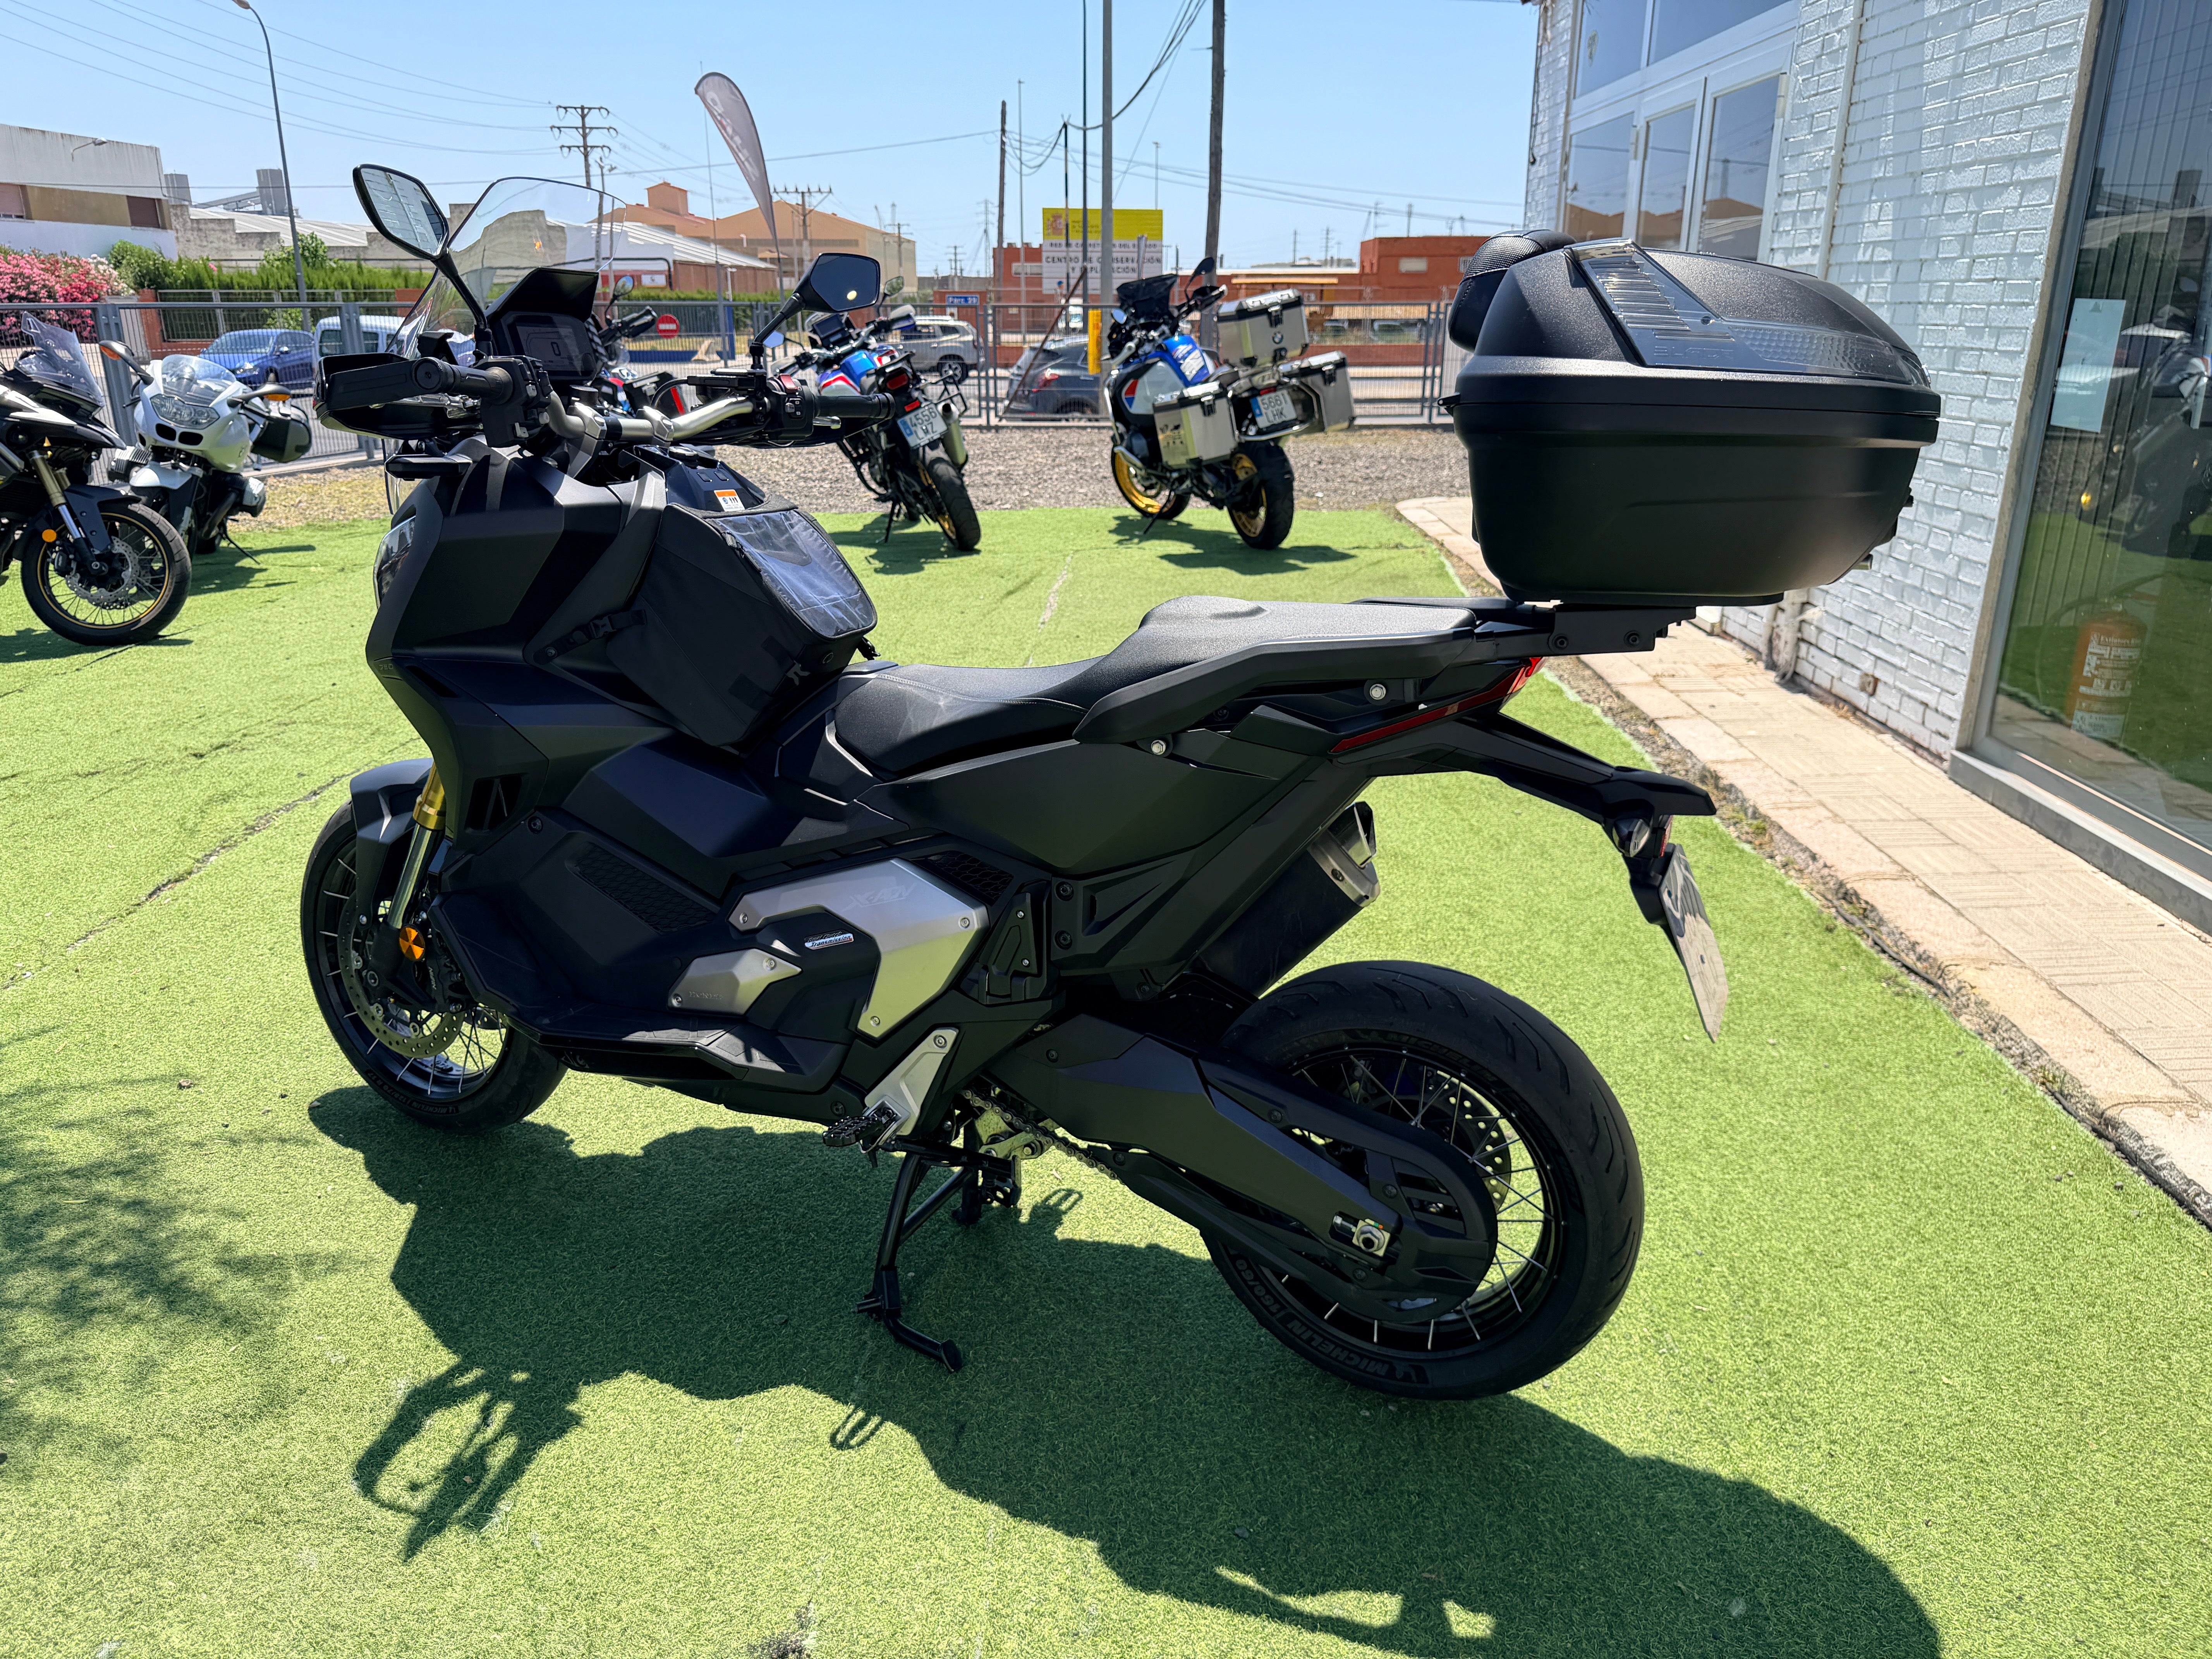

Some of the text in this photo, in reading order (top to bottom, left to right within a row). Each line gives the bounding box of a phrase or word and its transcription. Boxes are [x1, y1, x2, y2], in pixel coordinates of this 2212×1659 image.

[551, 342, 561, 356] 0
[1261, 393, 1288, 410] 5661
[910, 407, 938, 427] 4556
[1264, 407, 1287, 423] LHK
[811, 935, 851, 947] Transmission
[823, 931, 843, 939] Clutch
[411, 1101, 447, 1114] MICHELIN
[1235, 1259, 1391, 1377] MICHELIN 160/60
